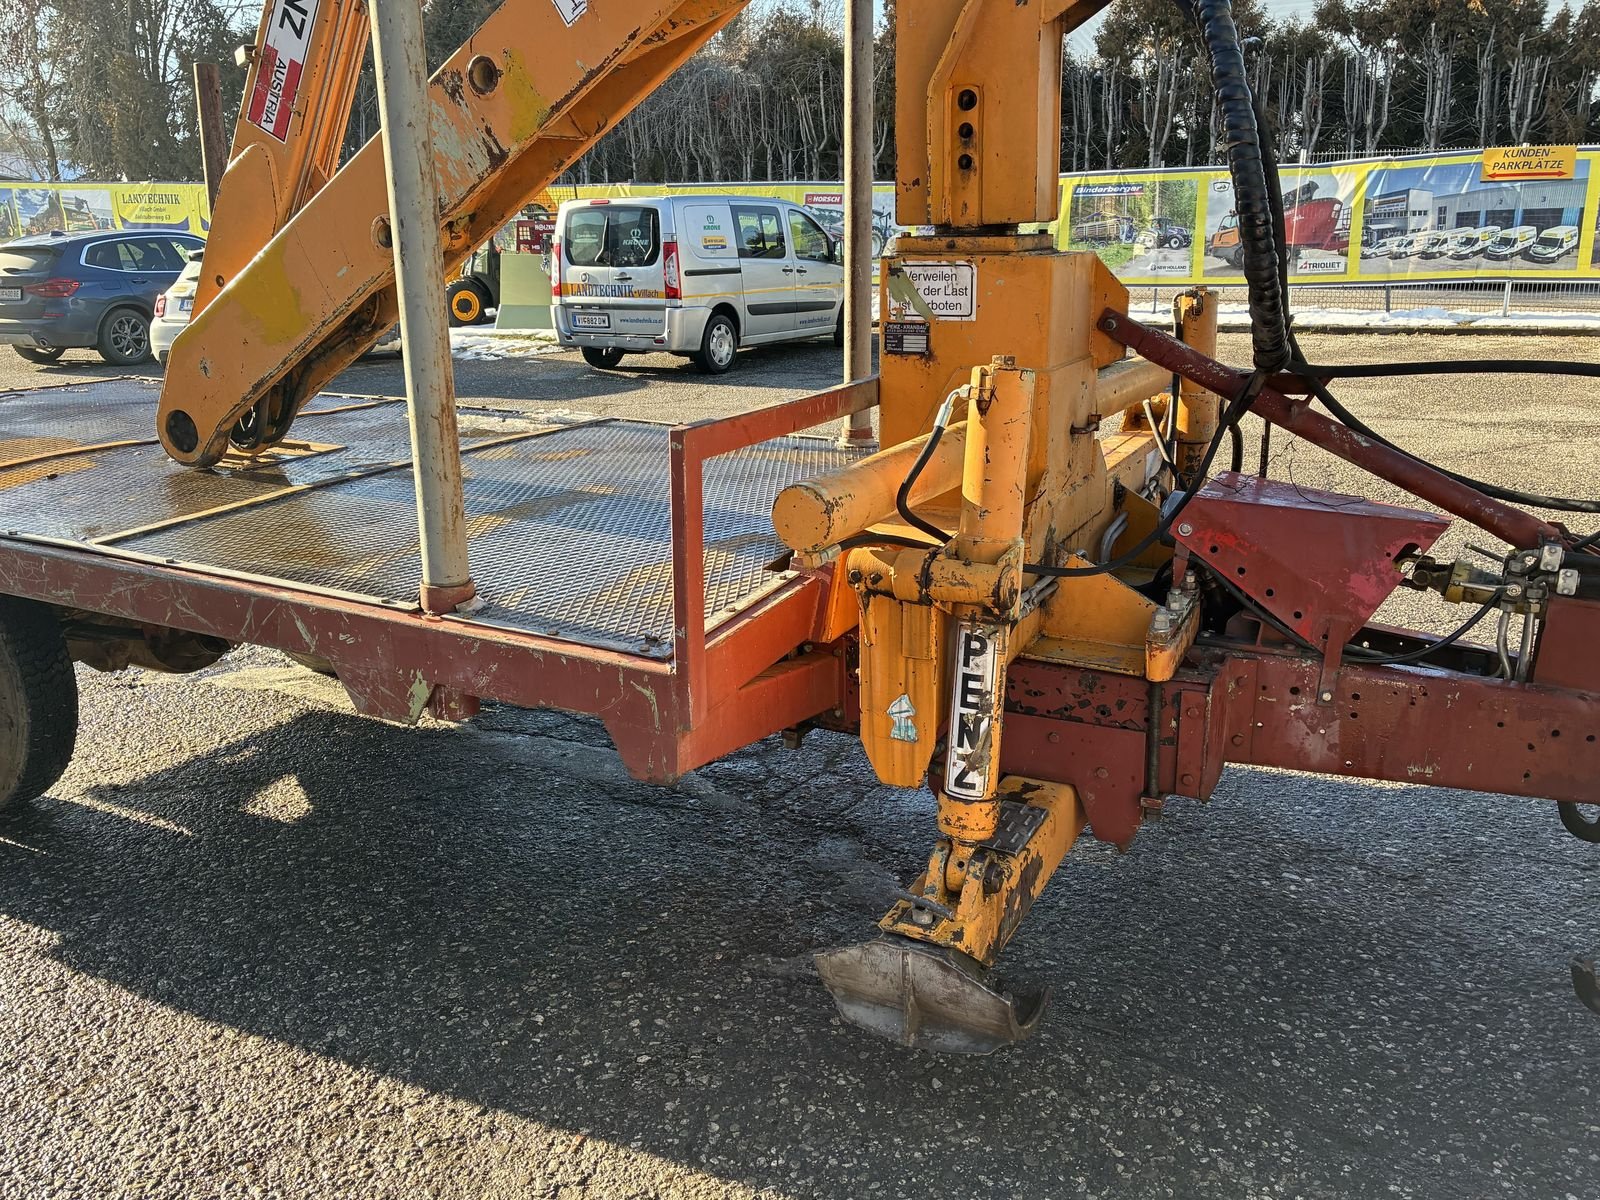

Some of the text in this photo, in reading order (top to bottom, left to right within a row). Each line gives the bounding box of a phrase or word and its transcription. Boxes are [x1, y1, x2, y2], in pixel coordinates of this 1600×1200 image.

[263, 58, 287, 125] AUSTRIA
[1503, 148, 1556, 158] KUNDEN-
[1492, 158, 1564, 170] PARKPLÄTZE
[122, 194, 181, 205] LANDTECHNIK
[570, 283, 634, 298] LANDTECHNIK
[923, 285, 941, 296] der
[944, 285, 968, 296] Last
[954, 633, 988, 790] PENZ
